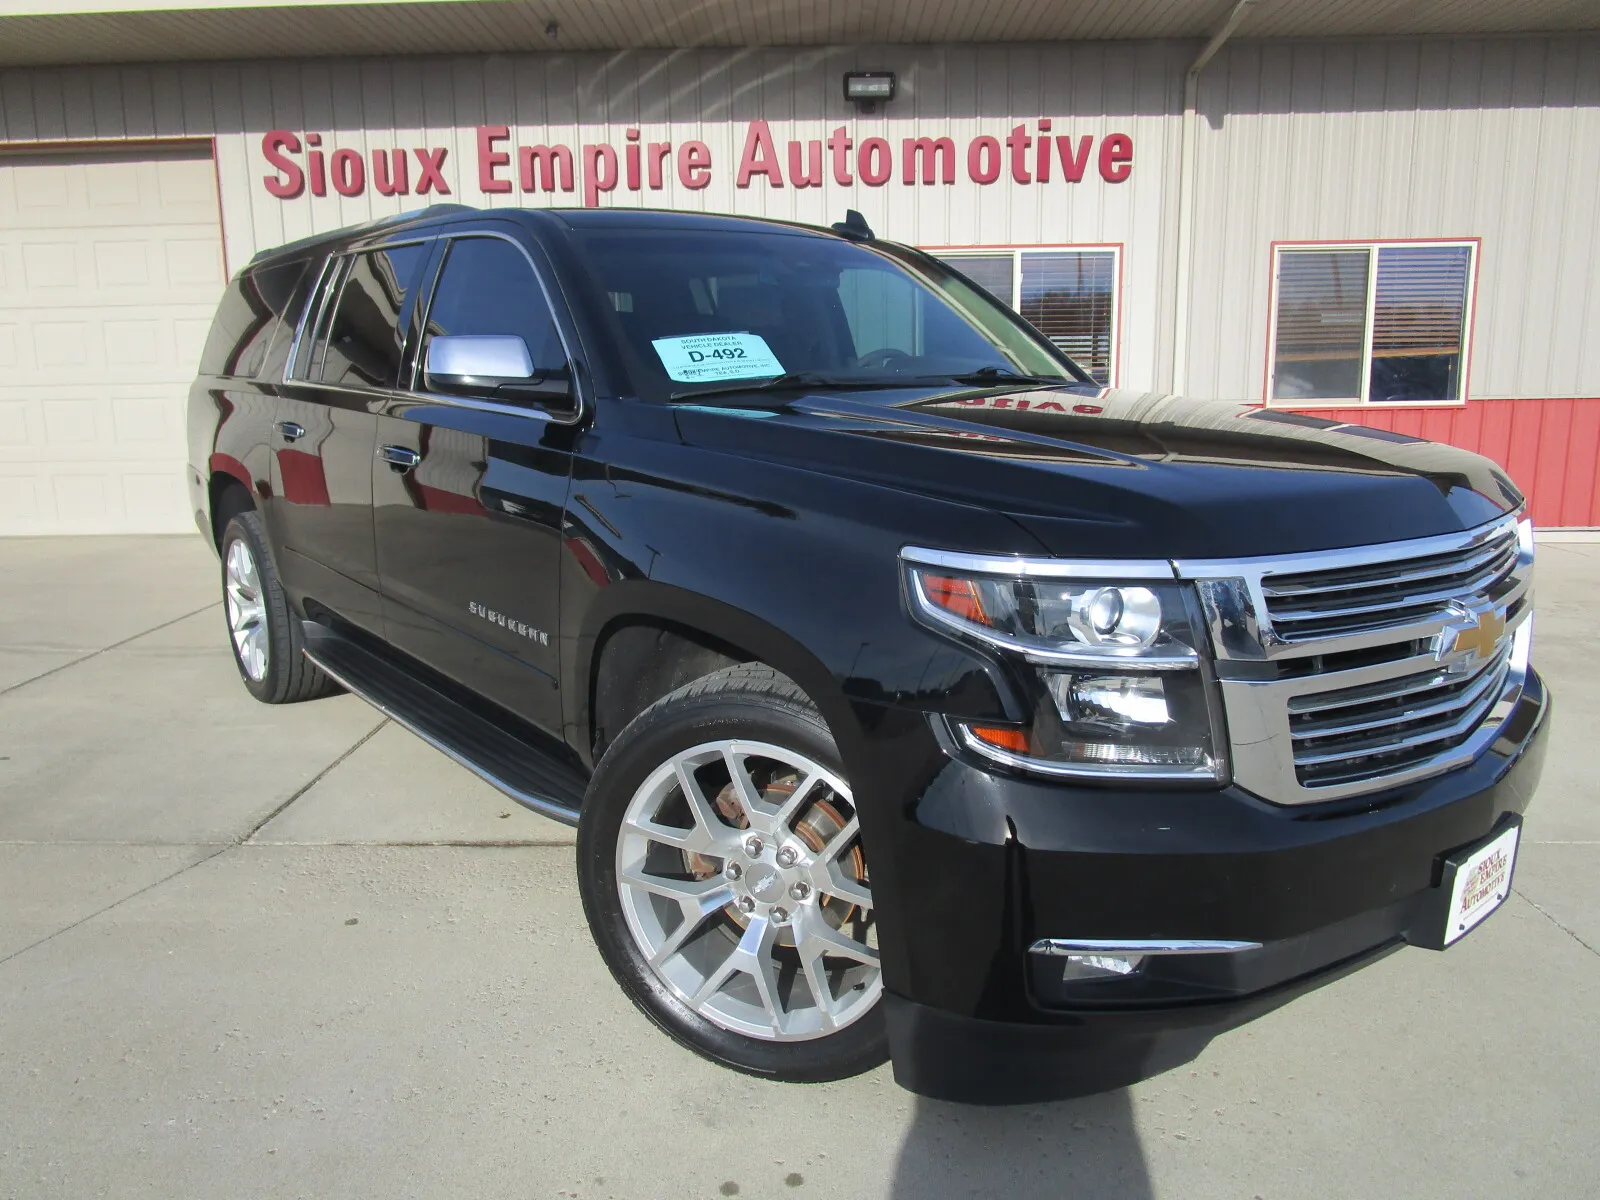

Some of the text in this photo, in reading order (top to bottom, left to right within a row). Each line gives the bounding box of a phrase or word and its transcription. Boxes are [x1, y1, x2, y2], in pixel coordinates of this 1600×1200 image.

[262, 119, 1134, 208] Sioux Empire Automotive
[688, 347, 748, 363] D-492
[468, 601, 548, 647] SUBURBAN
[1478, 847, 1502, 875] SIOUX
[1480, 854, 1508, 885] EMPIRE
